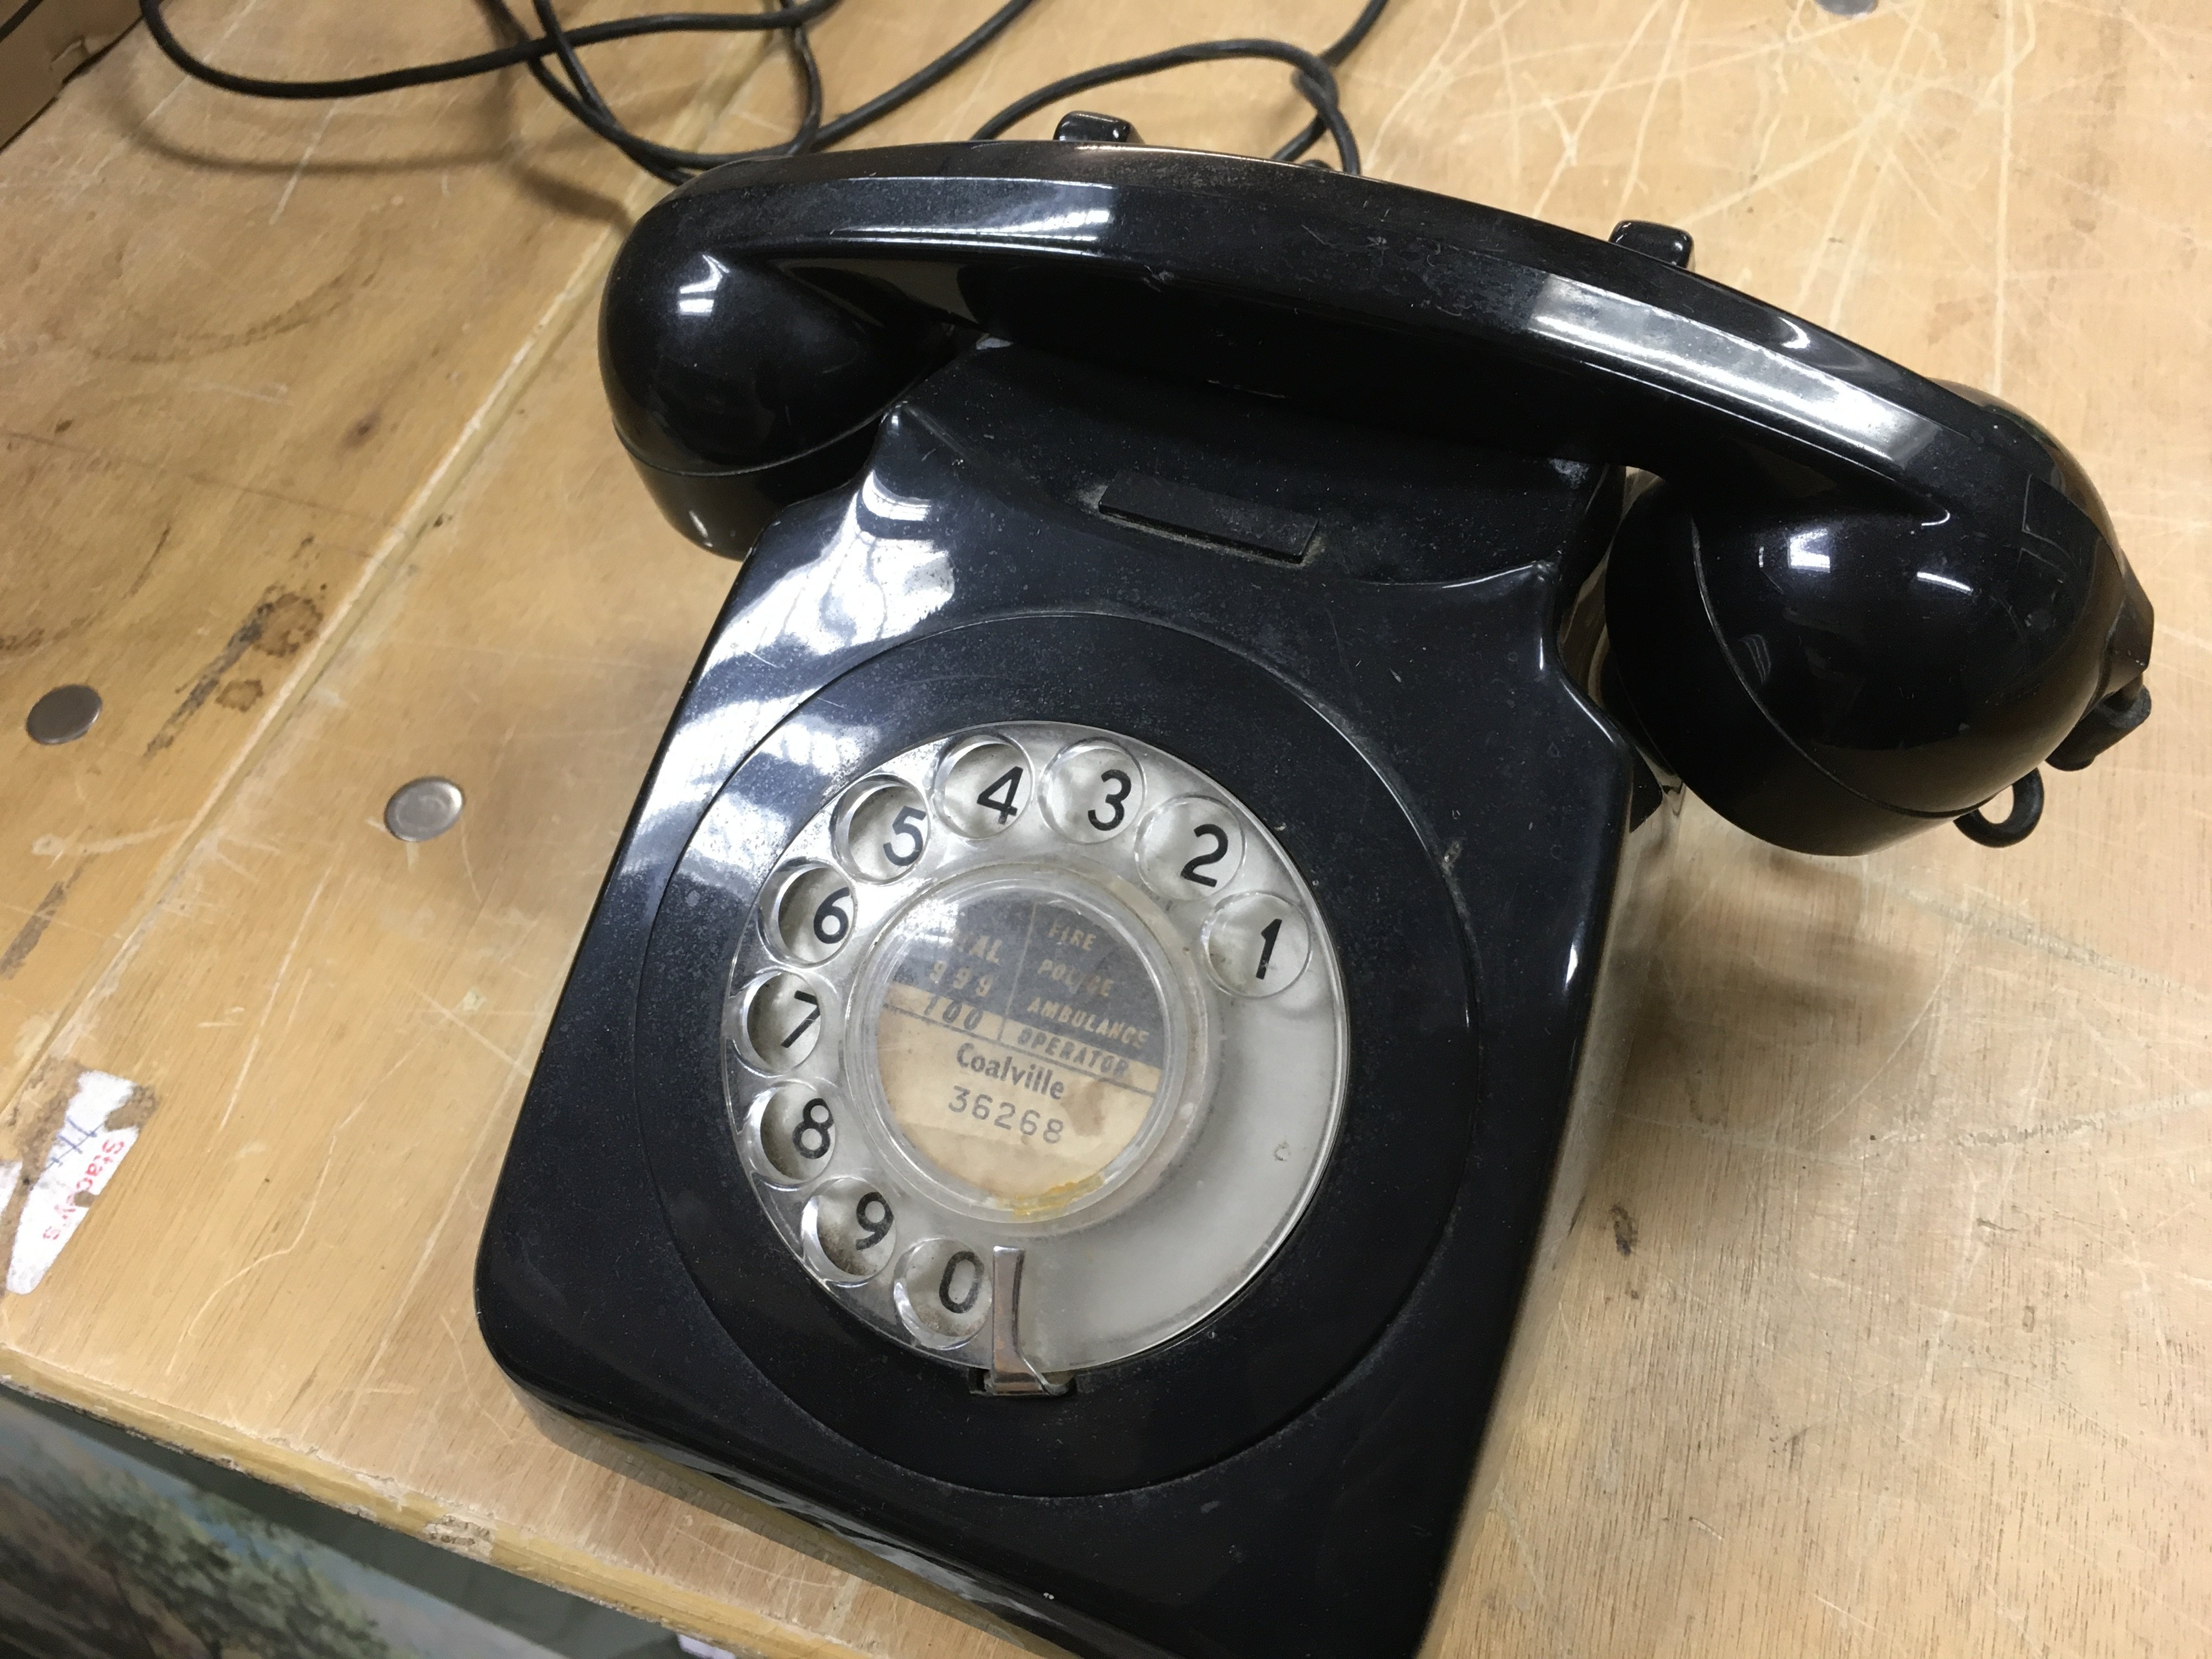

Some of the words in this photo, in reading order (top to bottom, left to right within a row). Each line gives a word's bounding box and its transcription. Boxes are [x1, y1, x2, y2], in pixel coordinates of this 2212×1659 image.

[977, 765, 1024, 824] 4
[1087, 769, 1132, 831] 3
[883, 806, 927, 866] 5
[1180, 823, 1228, 888] 2
[813, 887, 851, 944] 6
[1048, 921, 1097, 951] FIRE
[1037, 959, 1114, 998] POLCE
[1255, 918, 1283, 980] 1
[929, 961, 994, 997] 999
[782, 991, 821, 1049] 7
[924, 997, 984, 1030] 100
[1017, 1027, 1129, 1075] OPERATOR
[1026, 997, 1149, 1049] AMBULANCE
[957, 1042, 1064, 1100] Coalville
[792, 1097, 834, 1160] 8
[948, 1085, 1064, 1144] 36268
[856, 1190, 894, 1251] 9
[939, 1250, 985, 1314] 0
